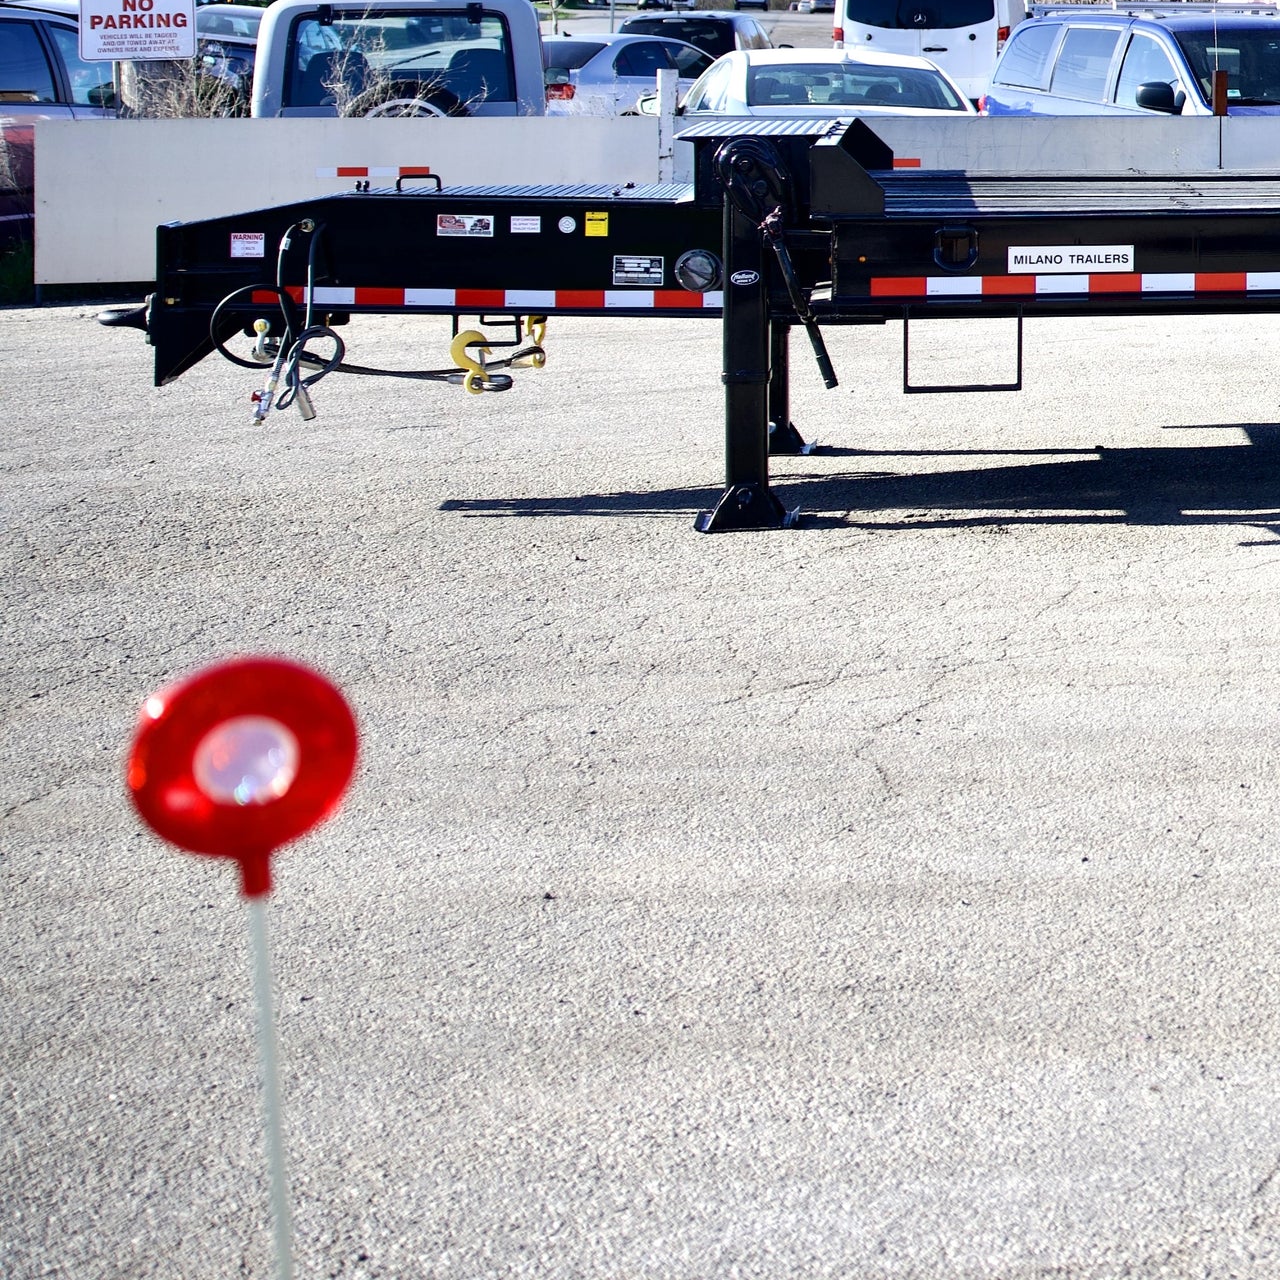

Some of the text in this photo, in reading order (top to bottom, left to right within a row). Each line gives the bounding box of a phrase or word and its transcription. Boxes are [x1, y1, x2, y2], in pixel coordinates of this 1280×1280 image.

[90, 13, 187, 30] PARKING
[1013, 254, 1129, 265] MILANO TRAILERS
